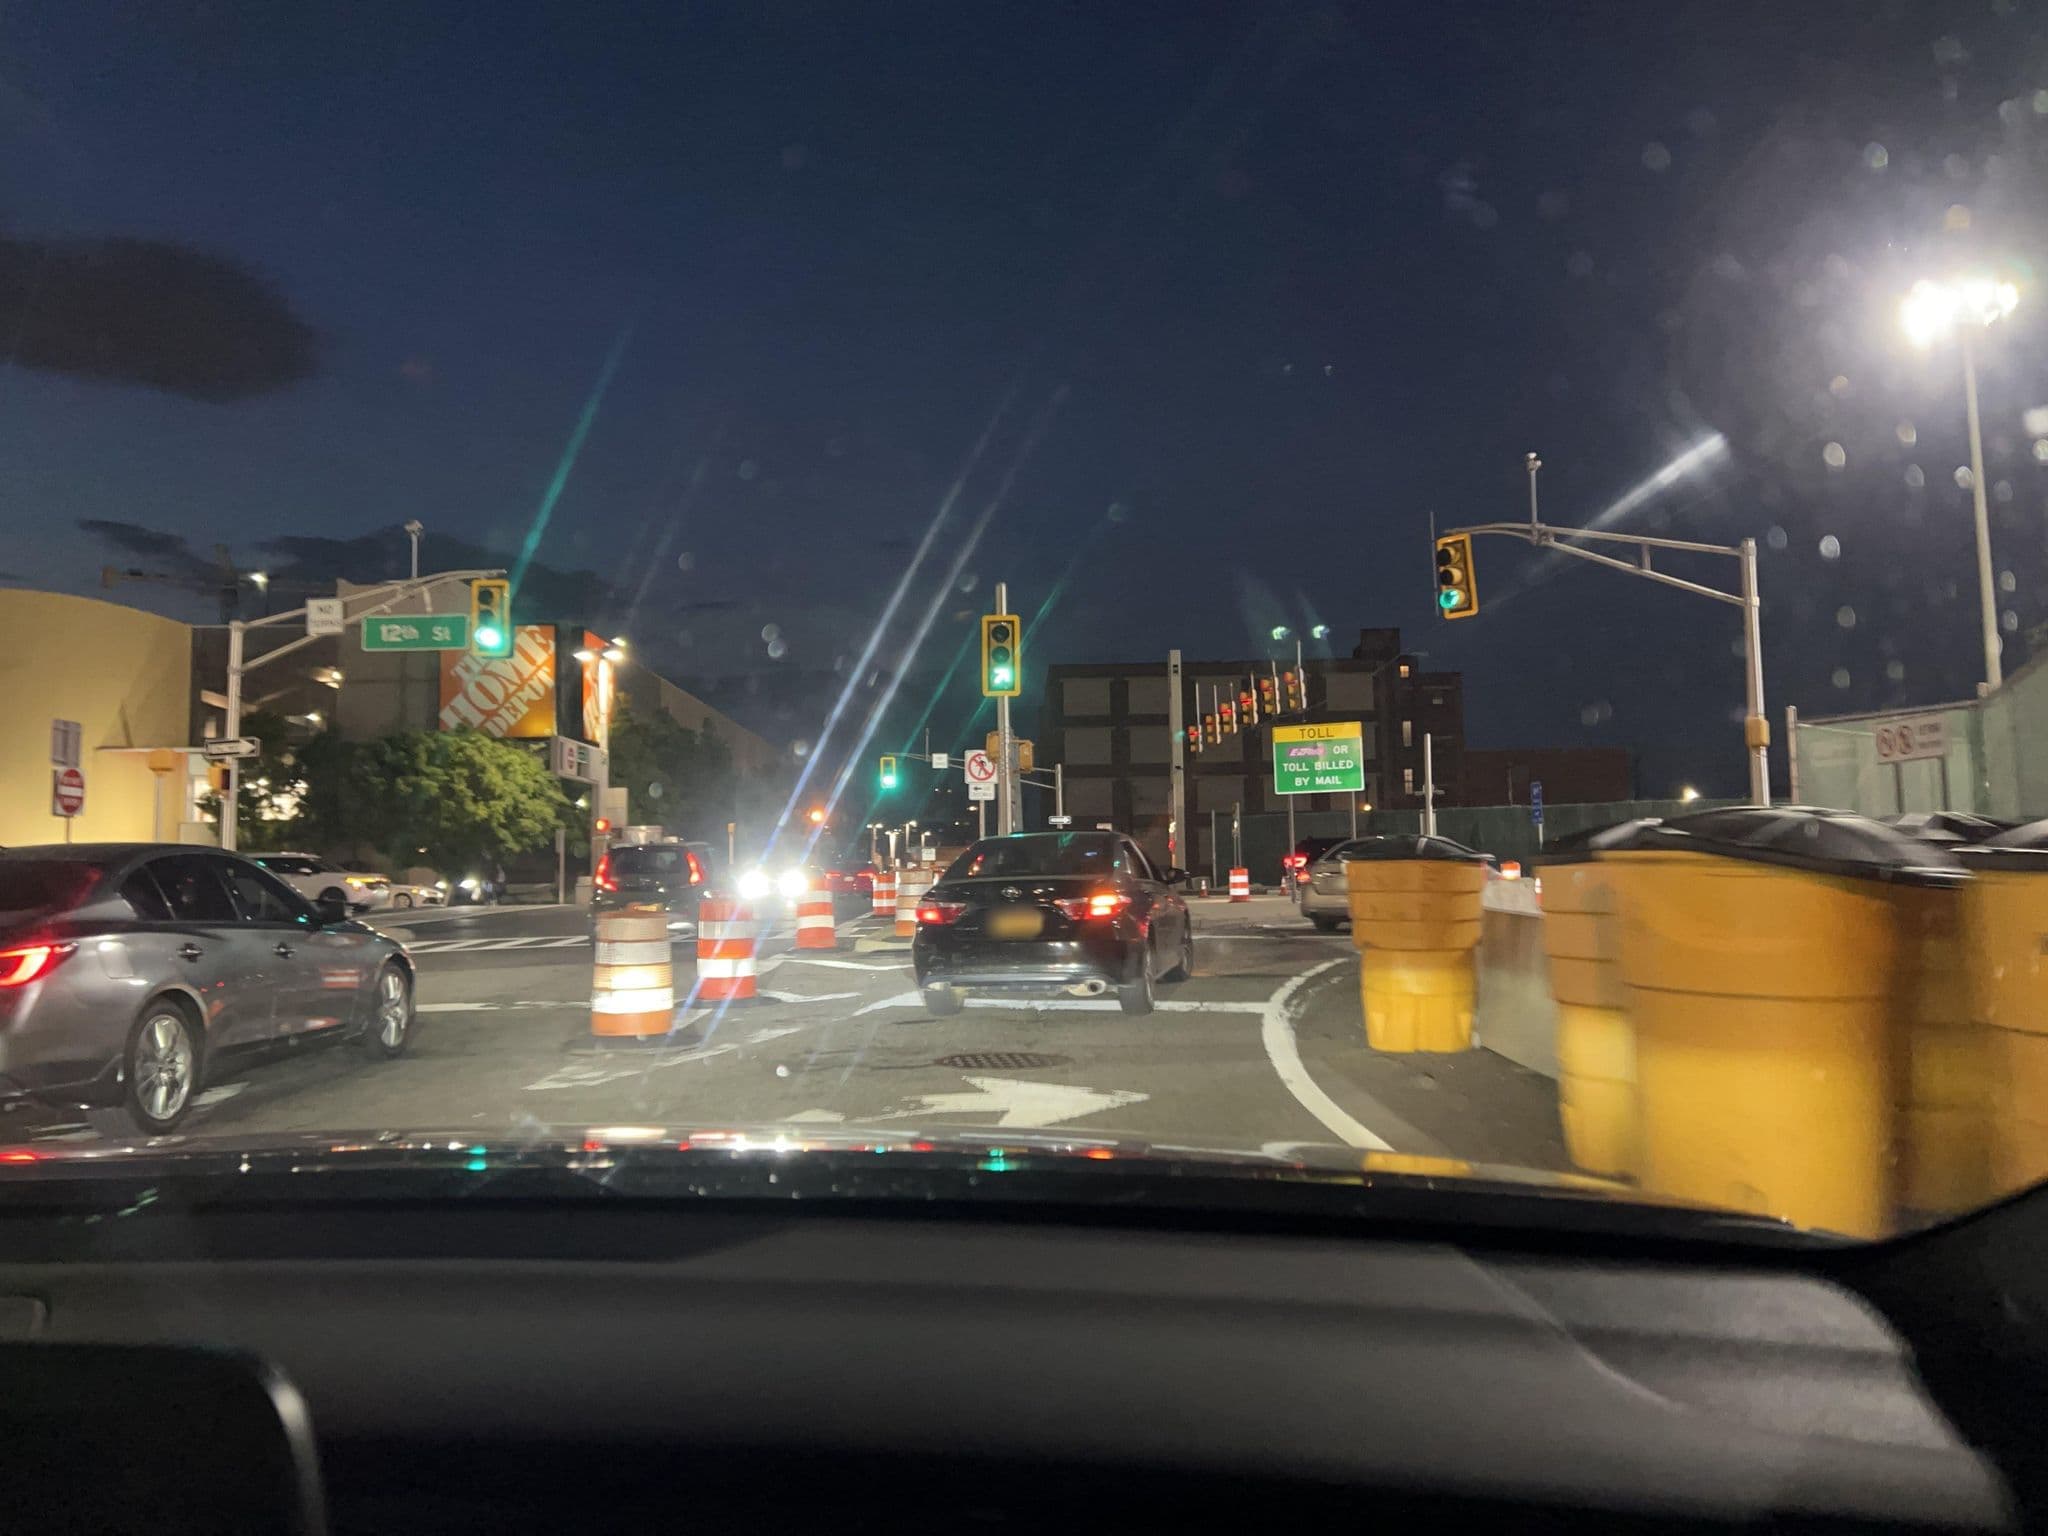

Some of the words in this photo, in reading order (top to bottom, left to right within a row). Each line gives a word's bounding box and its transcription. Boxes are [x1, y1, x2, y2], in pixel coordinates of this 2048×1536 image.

[380, 624, 420, 642] 12th
[431, 625, 452, 642] St
[439, 625, 556, 734] HOME
[484, 666, 555, 738] DEPOT
[1299, 728, 1335, 739] TOLL
[1333, 745, 1348, 754] OR
[1283, 763, 1309, 772] TOLL
[1314, 760, 1353, 770] BILLED
[1294, 777, 1310, 787] BY
[1315, 776, 1342, 785] MAIL
